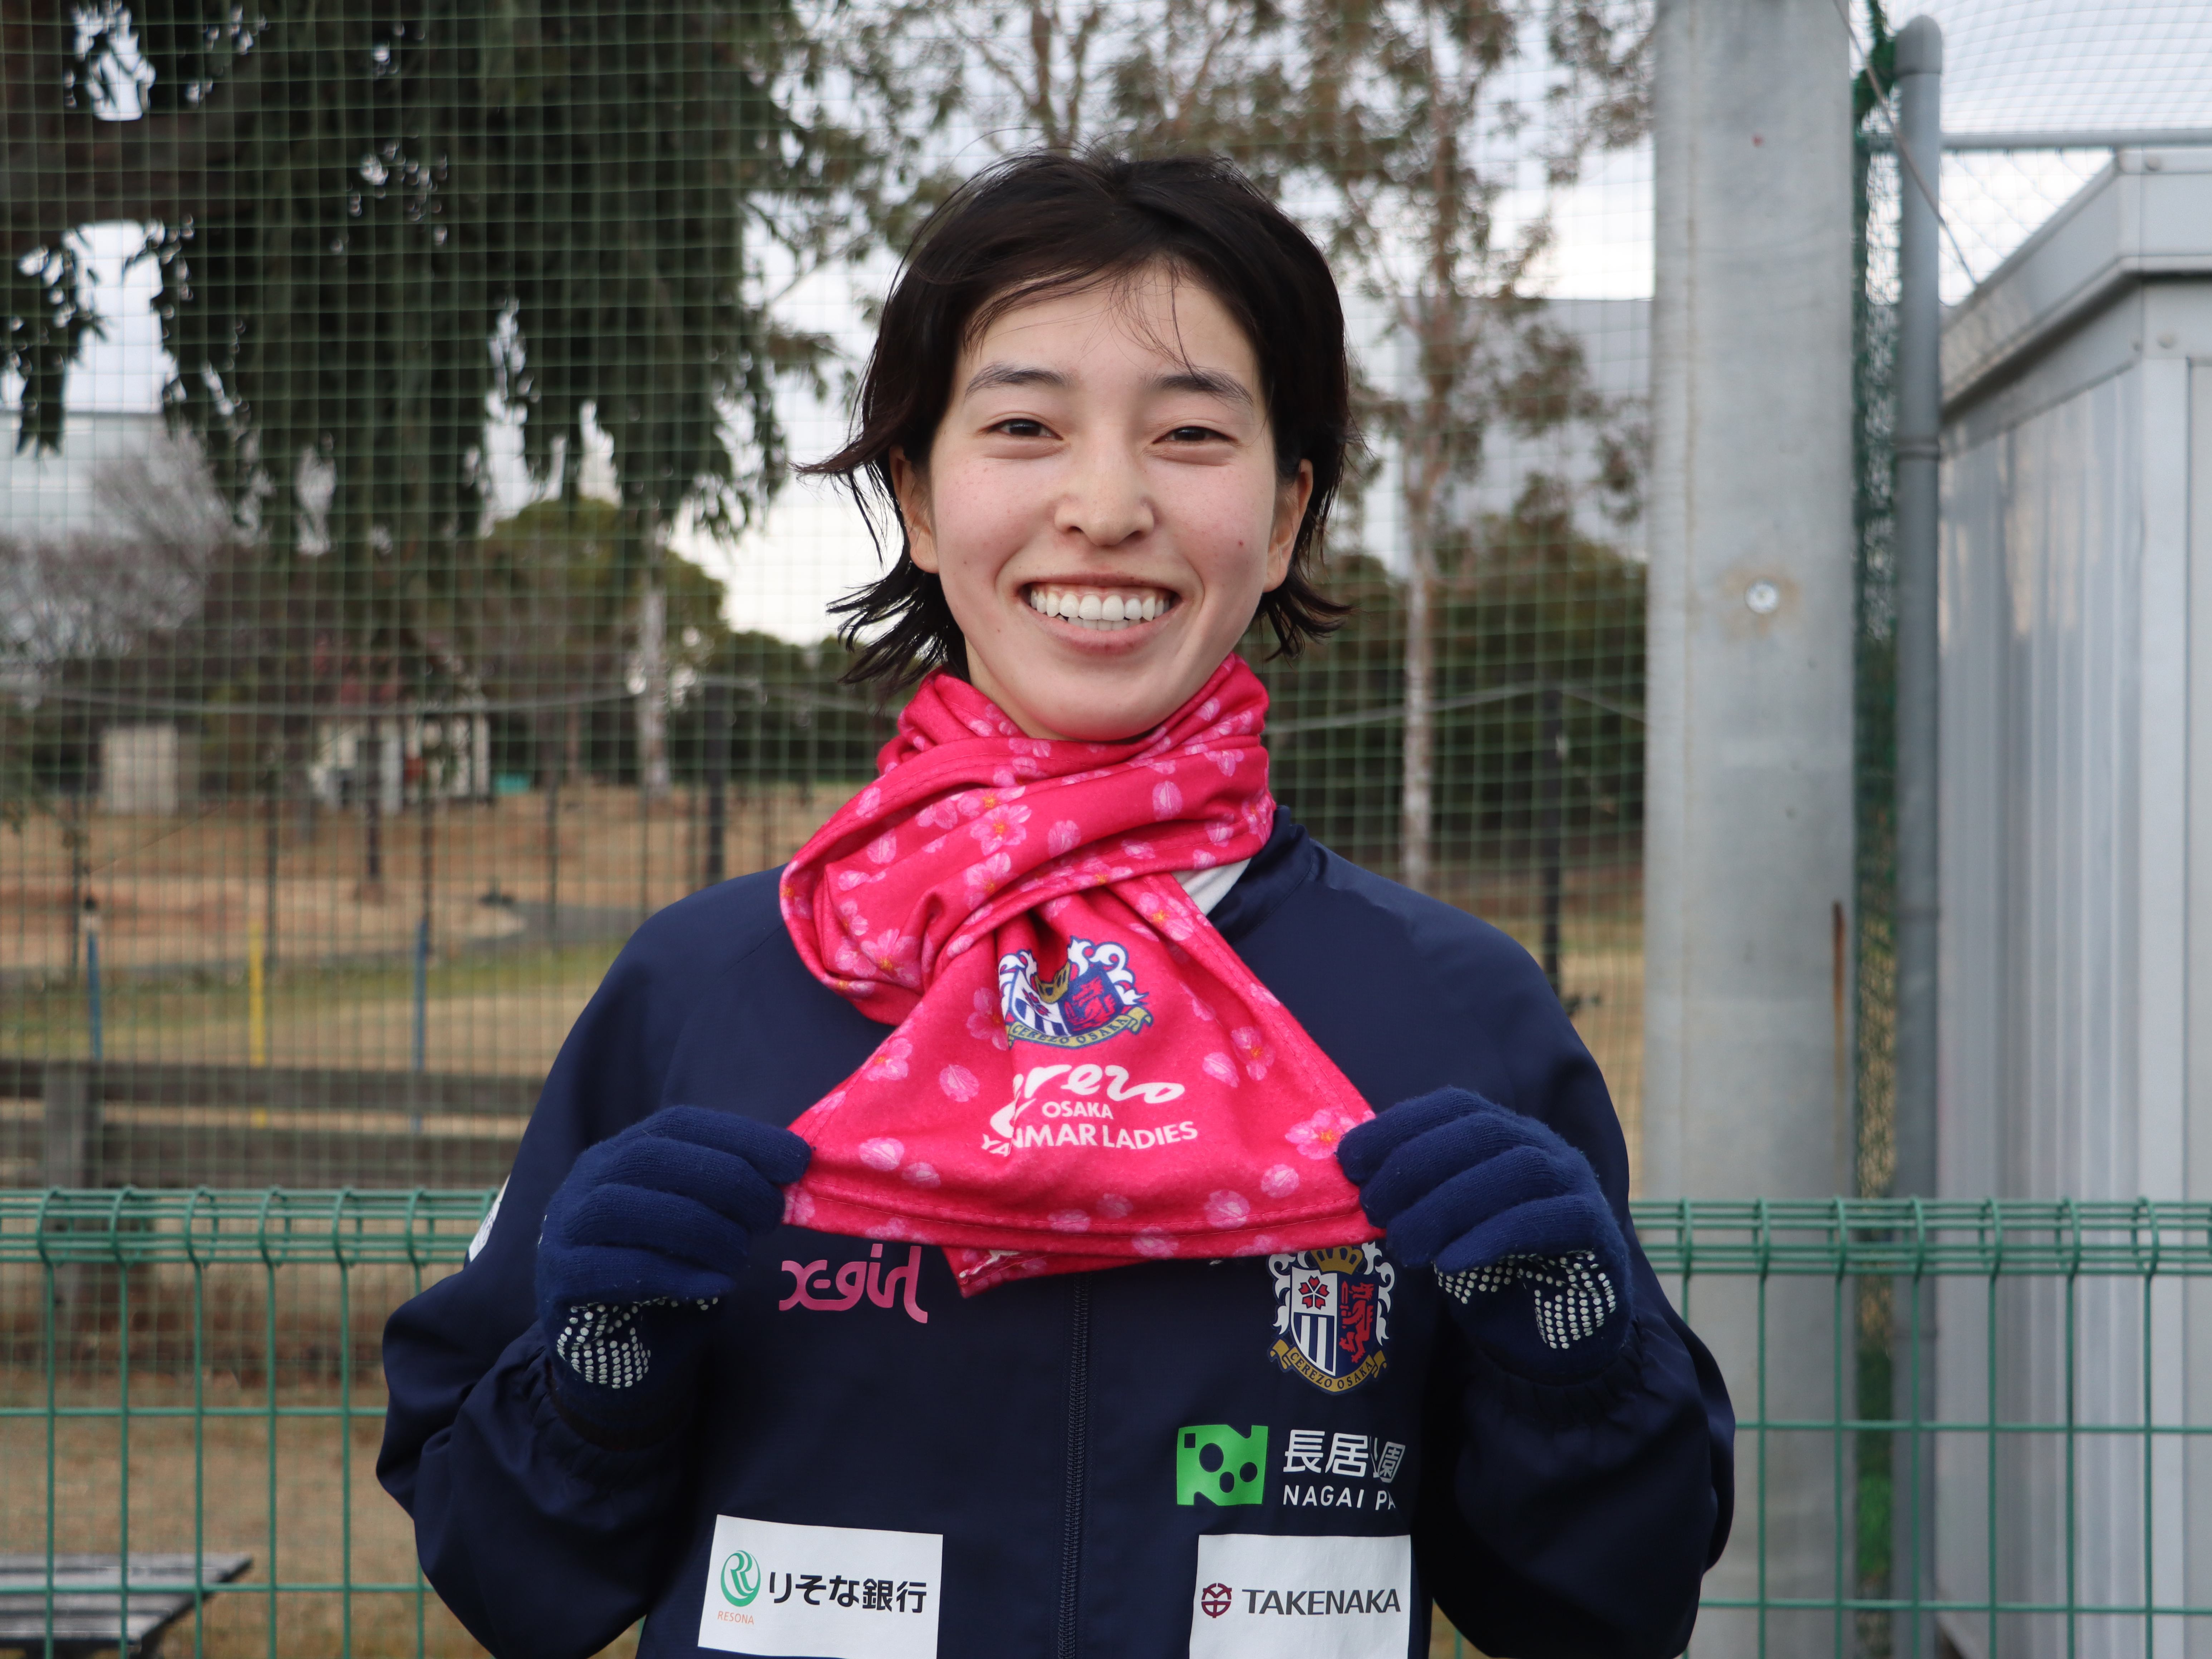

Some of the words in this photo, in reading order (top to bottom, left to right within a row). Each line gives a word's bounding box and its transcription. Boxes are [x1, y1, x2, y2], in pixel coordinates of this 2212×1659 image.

[1012, 1024, 1070, 1044] CEREZO
[1076, 1019, 1127, 1044] OSAKA
[1042, 1101, 1114, 1119] OSAKA
[1103, 1121, 1198, 1150] LADIES
[1290, 1352, 1332, 1388] CEREZO
[1337, 1362, 1373, 1389] OSAKA
[1283, 1485, 1365, 1508] NAGAI
[770, 1572, 927, 1613] りそな銀行
[1242, 1589, 1401, 1615] TAKENAKA
[717, 1611, 754, 1625] RESONA
